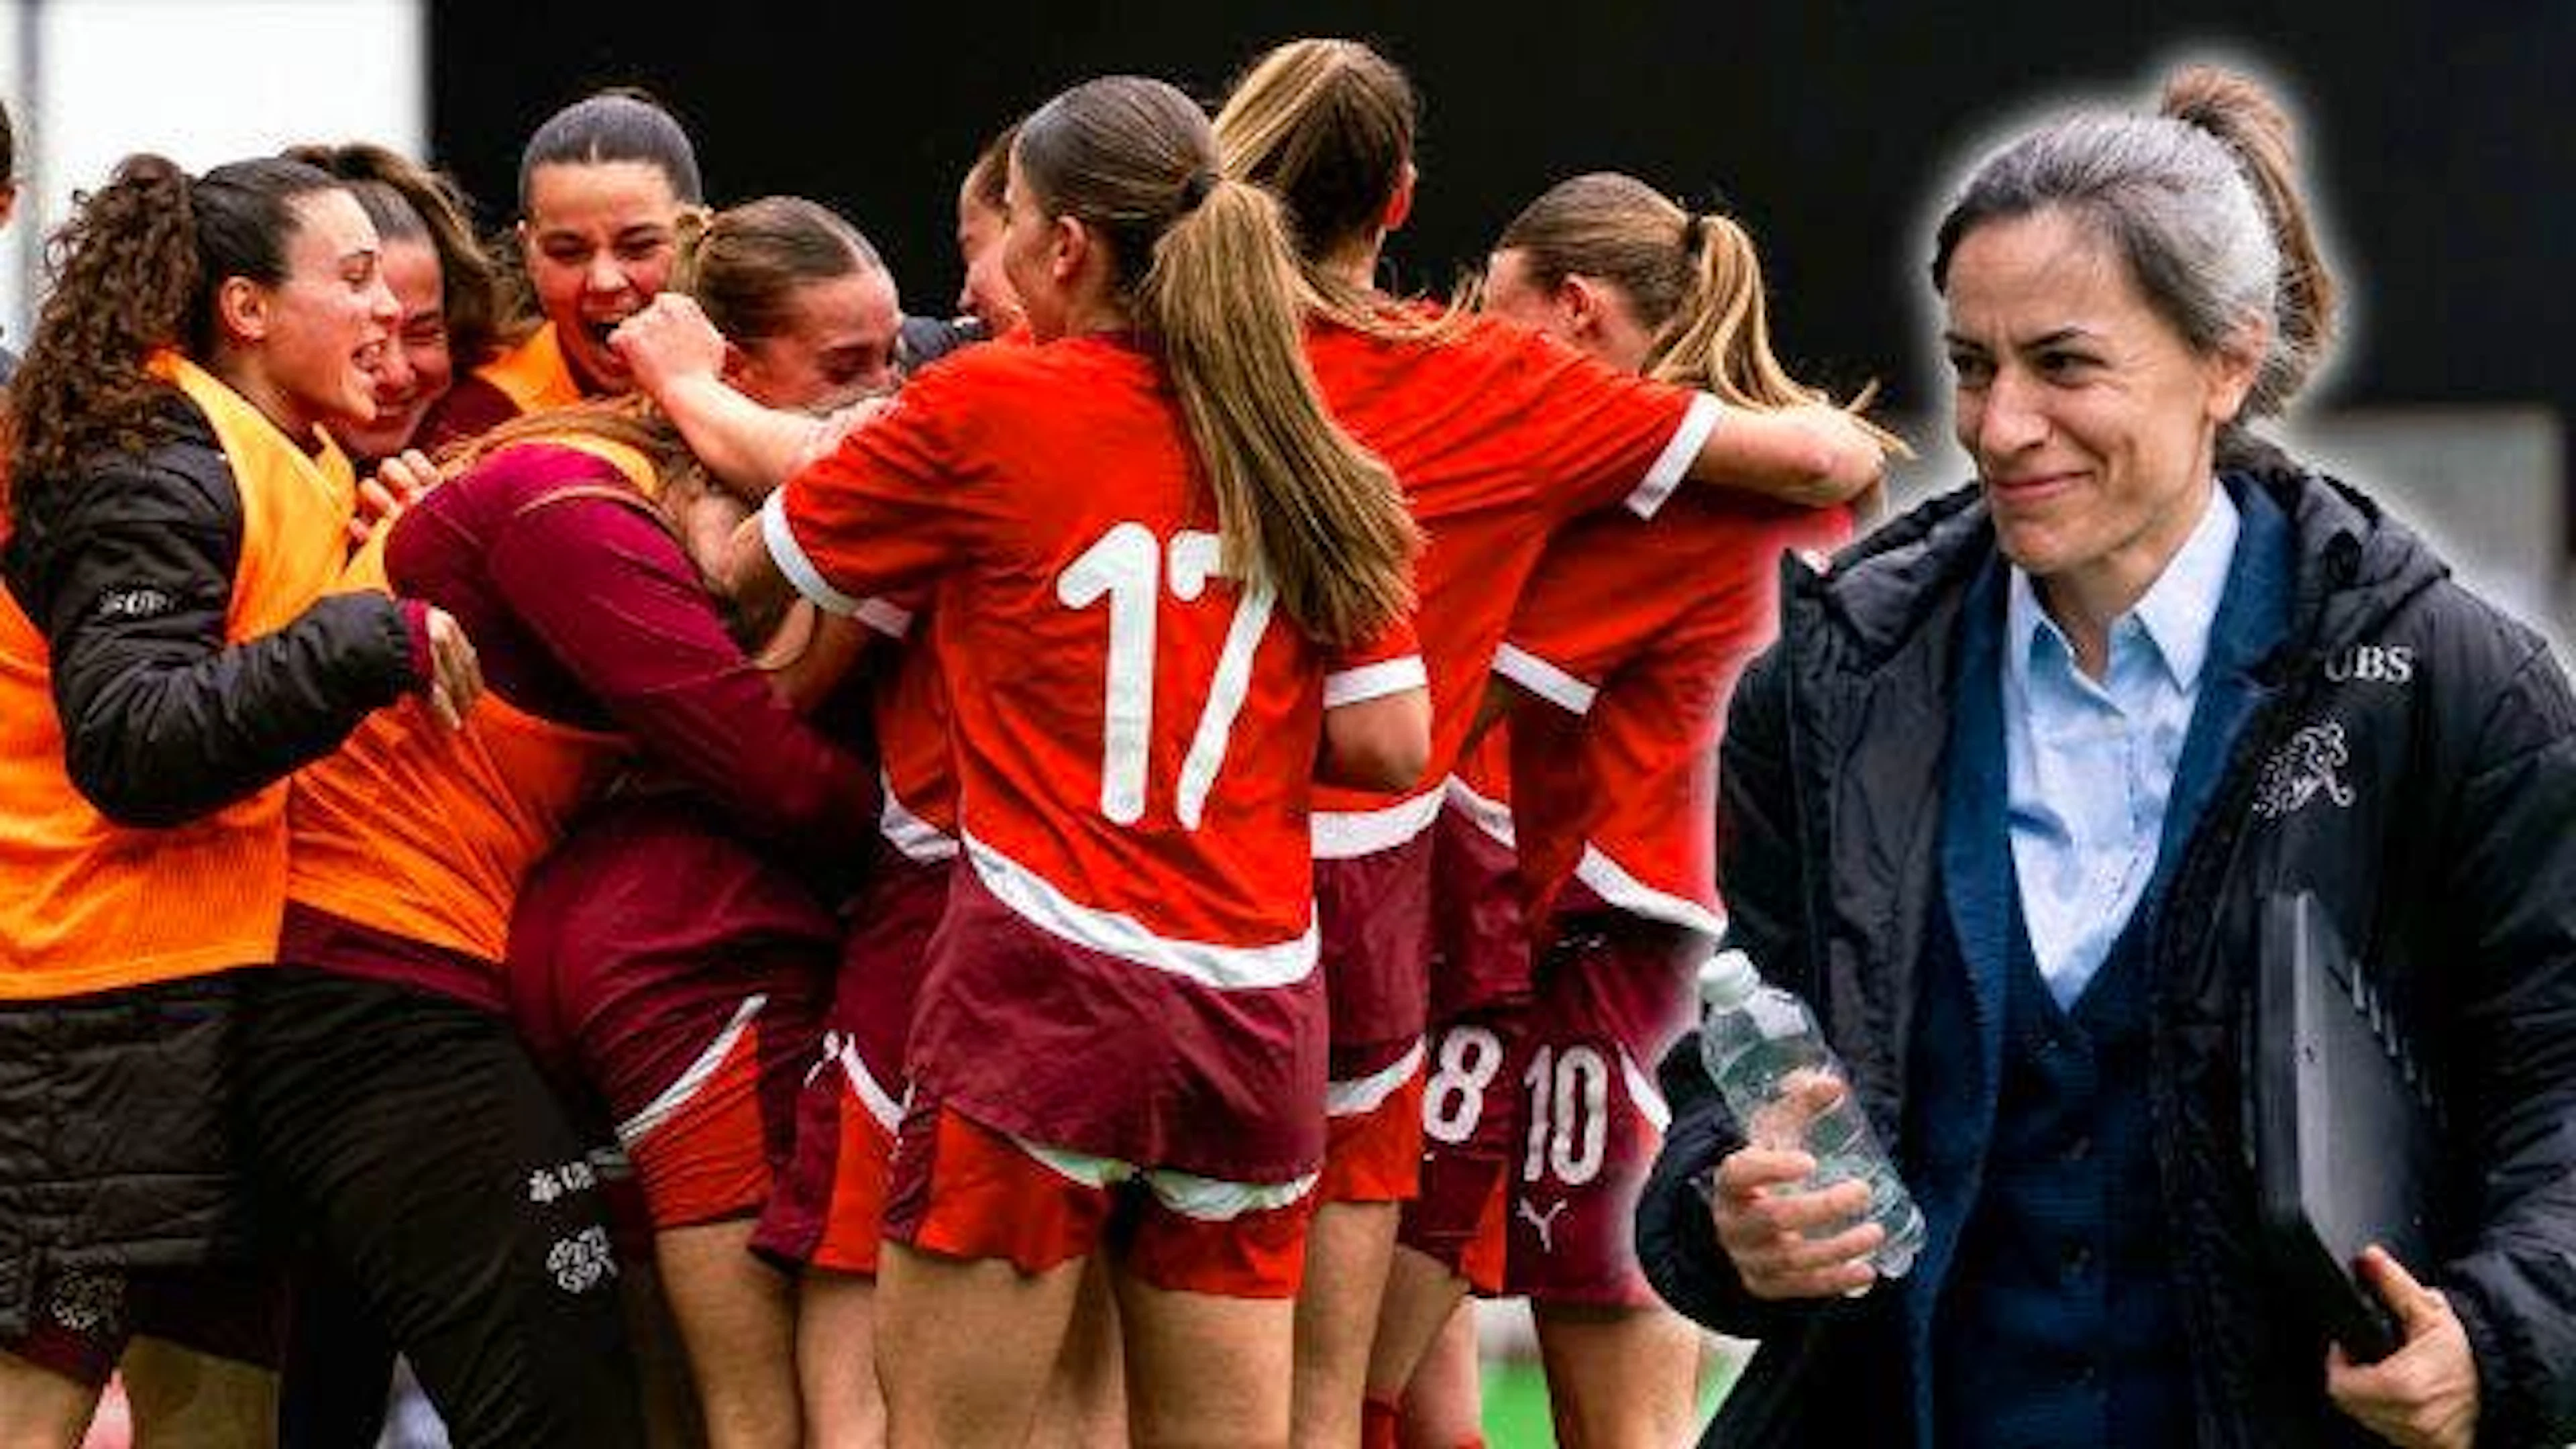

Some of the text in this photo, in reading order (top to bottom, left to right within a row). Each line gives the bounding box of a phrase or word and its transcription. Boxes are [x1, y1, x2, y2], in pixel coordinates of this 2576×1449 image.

[1057, 521, 1277, 832] 17
[2324, 645, 2413, 682] UBS
[1524, 1044, 1608, 1186] 10
